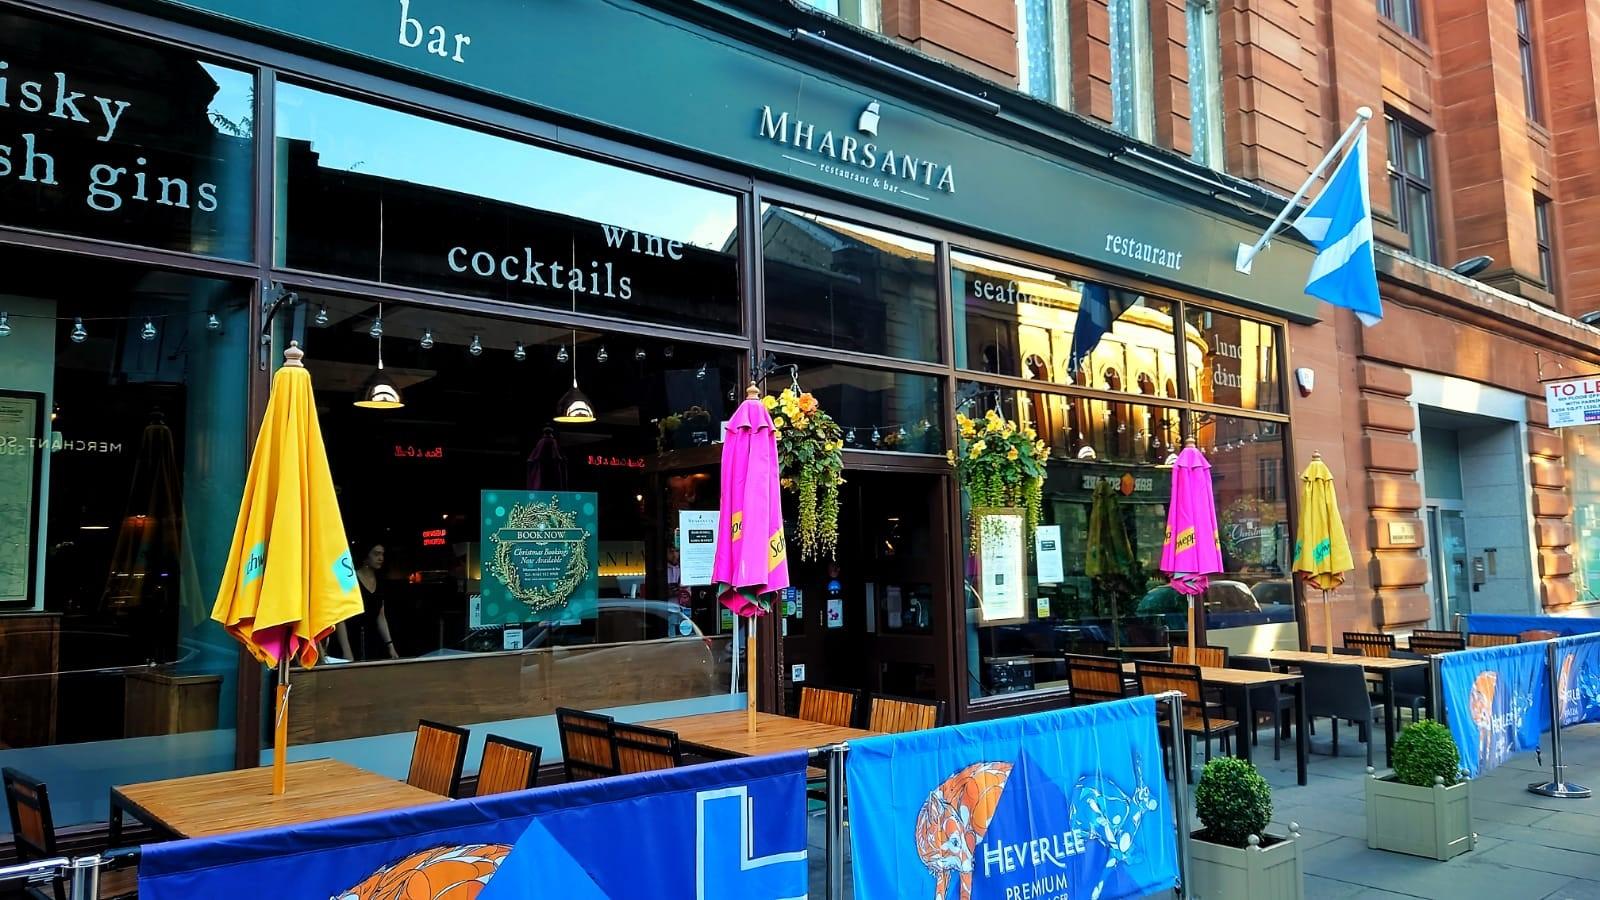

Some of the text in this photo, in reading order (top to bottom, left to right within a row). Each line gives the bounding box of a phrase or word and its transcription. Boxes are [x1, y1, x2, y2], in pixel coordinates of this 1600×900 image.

[398, 1, 470, 63] bar
[0, 61, 131, 142] isky
[759, 104, 955, 193] MHARSANTA
[86, 156, 217, 212] gins
[819, 162, 899, 193] restaurant & bar
[600, 223, 683, 260] wine
[1105, 232, 1183, 271] restaurant
[447, 246, 632, 300] cocktails
[1550, 384, 1576, 397] TO
[517, 530, 566, 540] BOOK NOW
[982, 828, 1087, 878] HEVERLEE
[1005, 872, 1068, 900] PREMIUM
